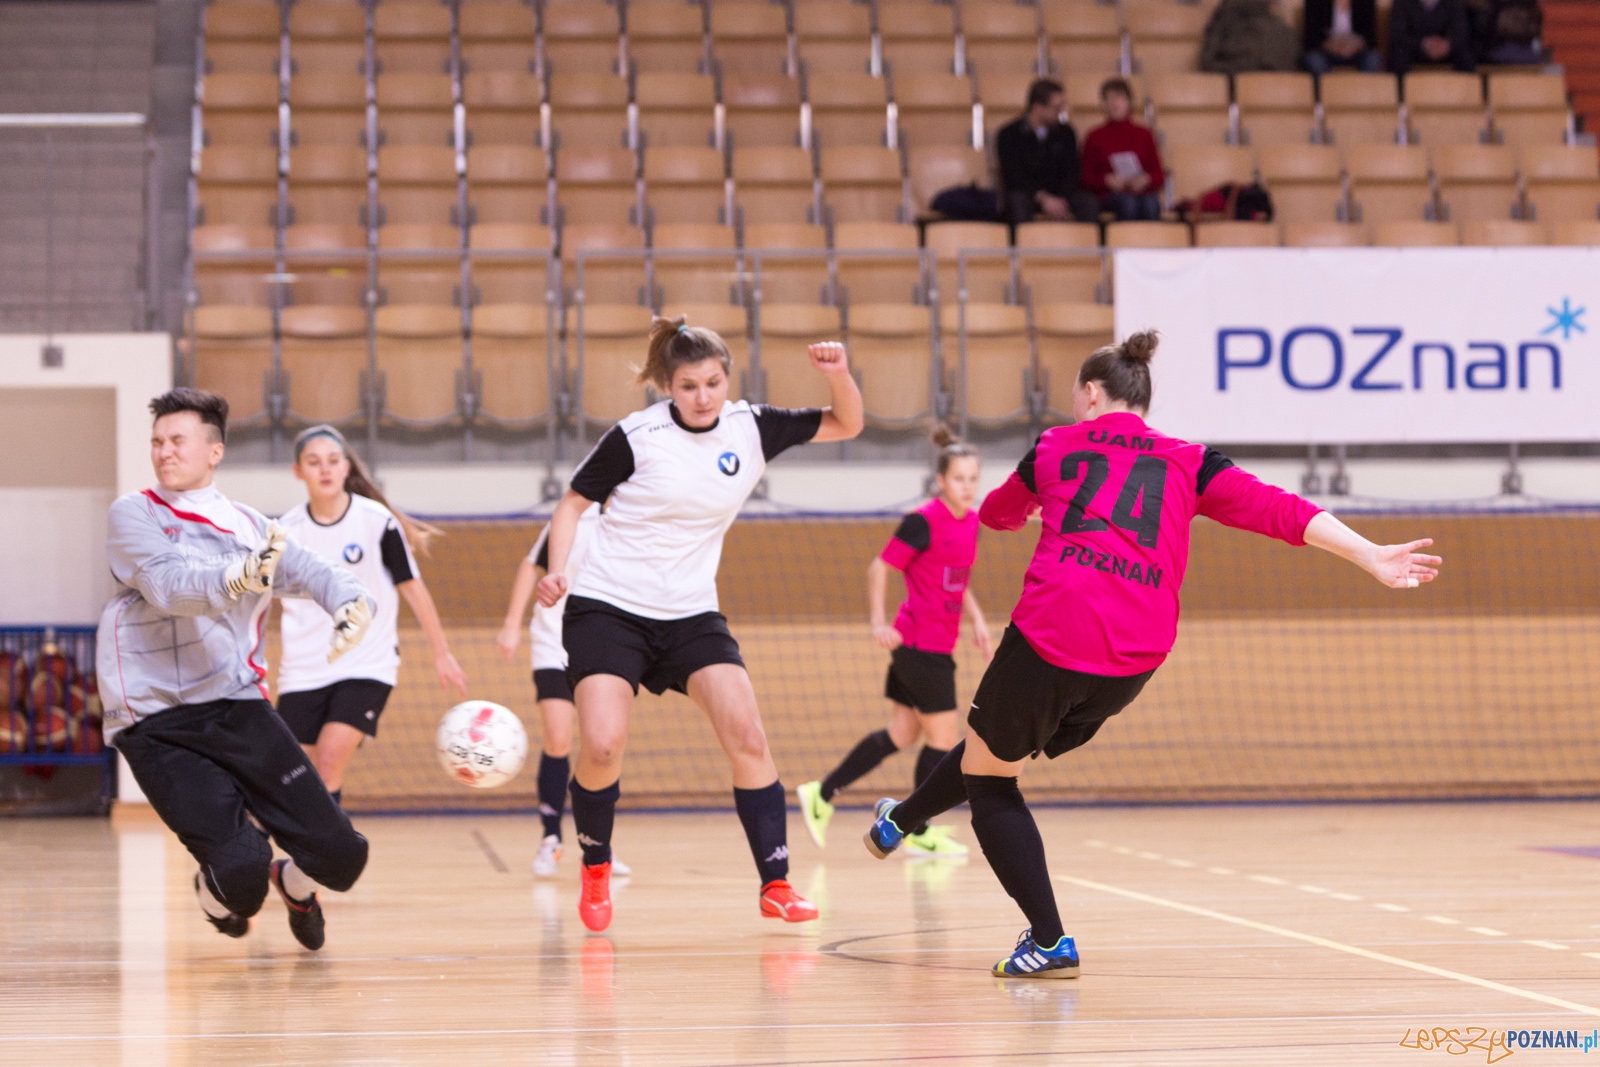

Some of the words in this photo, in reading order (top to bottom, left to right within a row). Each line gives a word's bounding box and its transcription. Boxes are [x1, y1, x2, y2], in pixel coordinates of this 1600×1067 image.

[1087, 430, 1155, 451] UAM
[1060, 450, 1167, 550] 24
[1059, 546, 1163, 589] POZNAŃ
